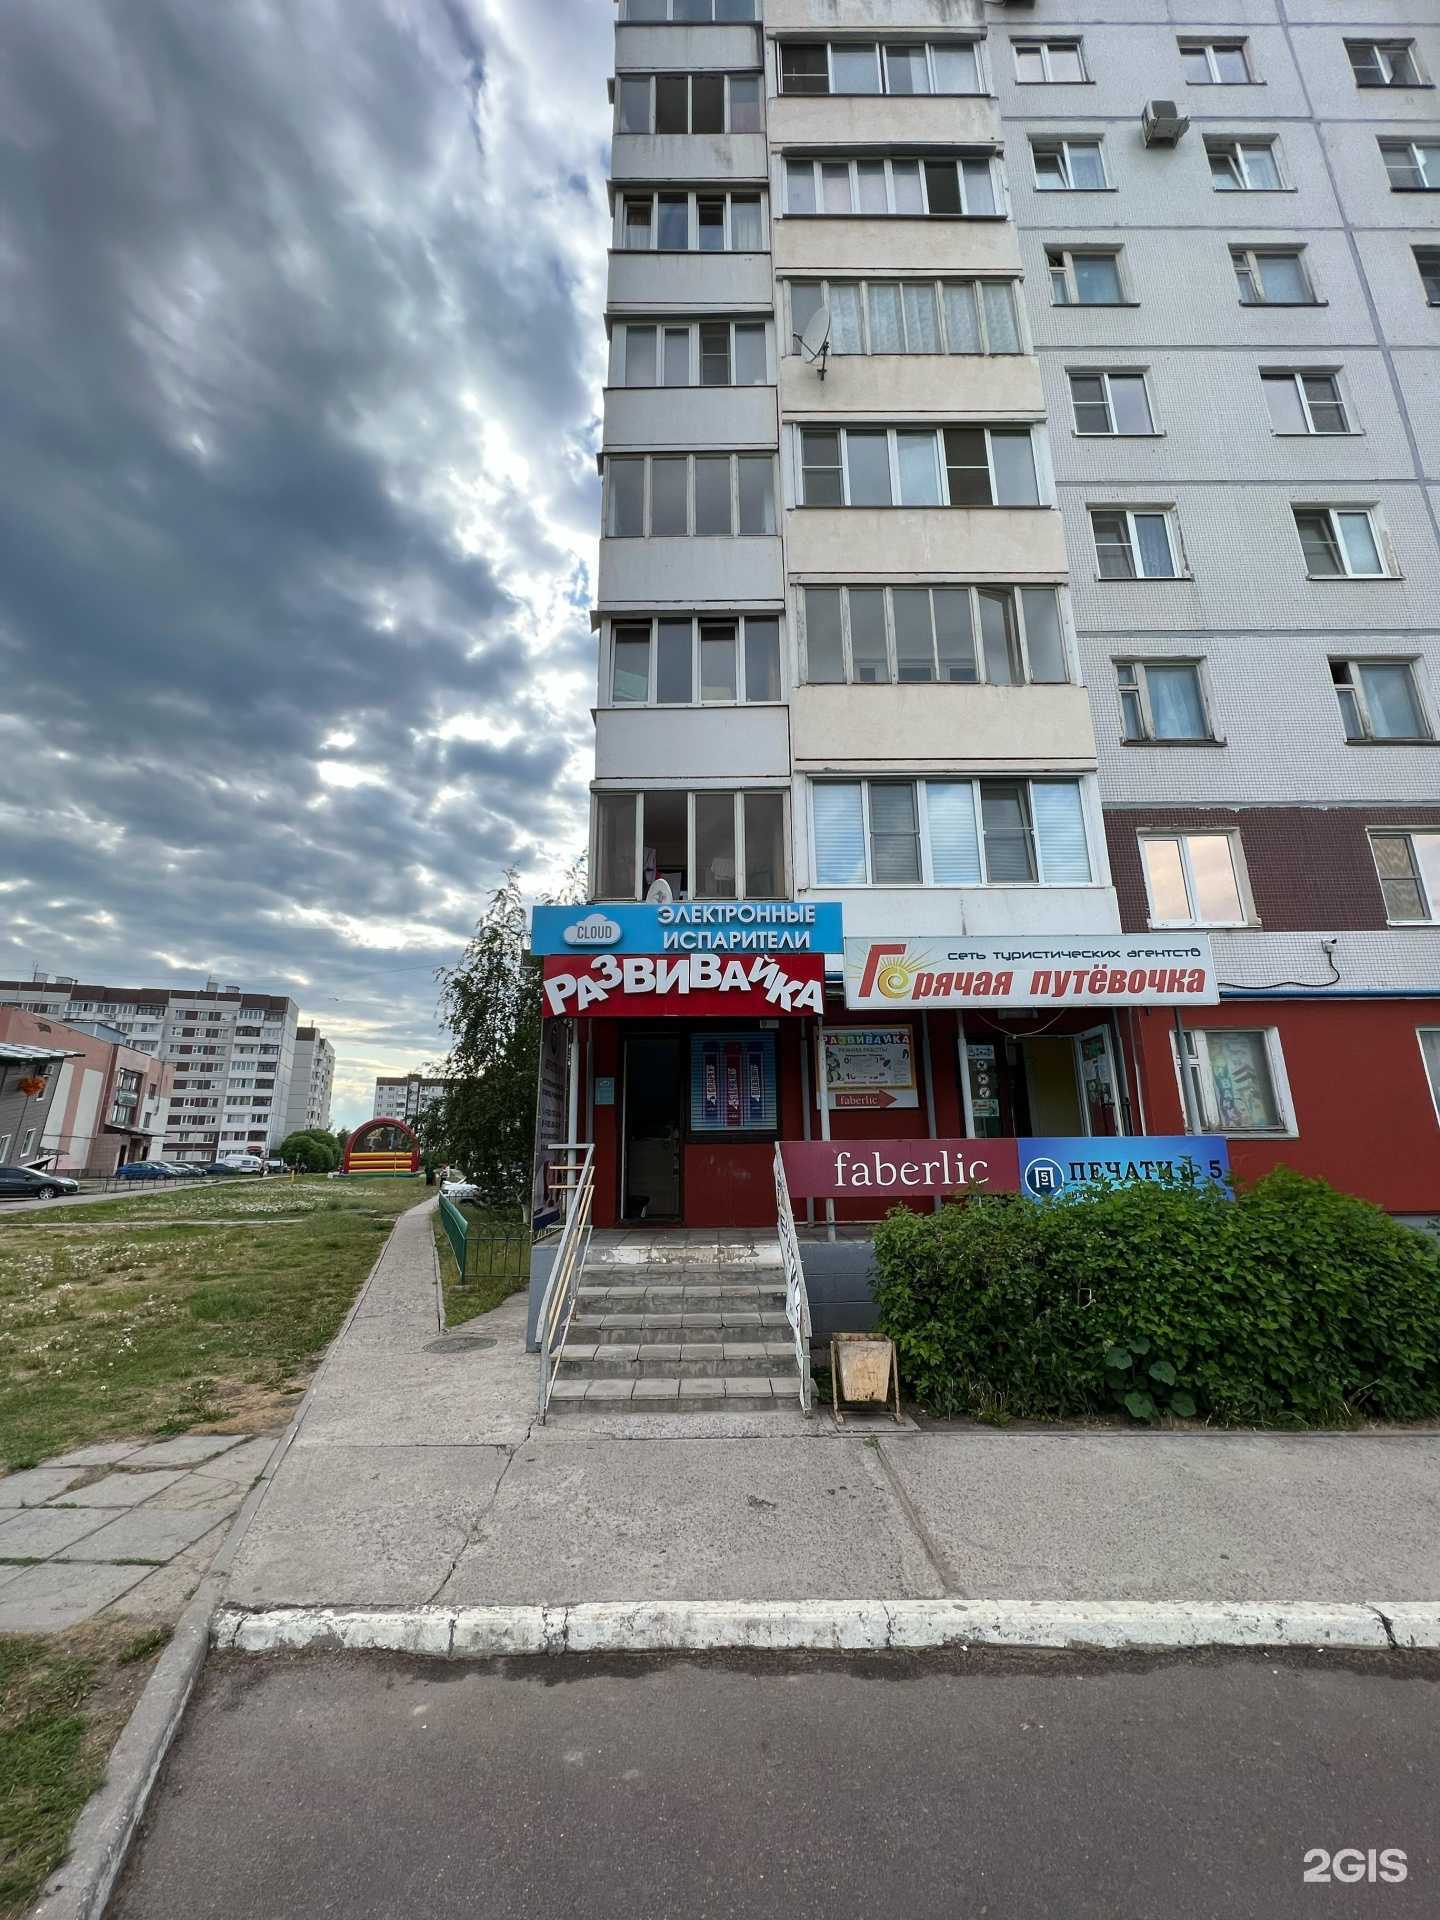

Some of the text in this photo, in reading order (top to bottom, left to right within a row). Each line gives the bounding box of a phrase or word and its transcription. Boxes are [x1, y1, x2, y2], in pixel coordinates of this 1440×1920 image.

[657, 905, 816, 925] ЭЛЕКТРОННЫЕ
[577, 925, 612, 939] CLOUD
[663, 930, 811, 950] ИСПАРИТЕЛИ
[947, 947, 1202, 961] сеть туристических агентств
[857, 943, 1207, 1000] Горячая путёвочка
[542, 953, 824, 1016] РАЗВИВАЙКА
[840, 1095, 879, 1105] faberlic
[833, 1150, 990, 1187] faberlic
[1068, 1160, 1174, 1181] ПЕЧАТИ
